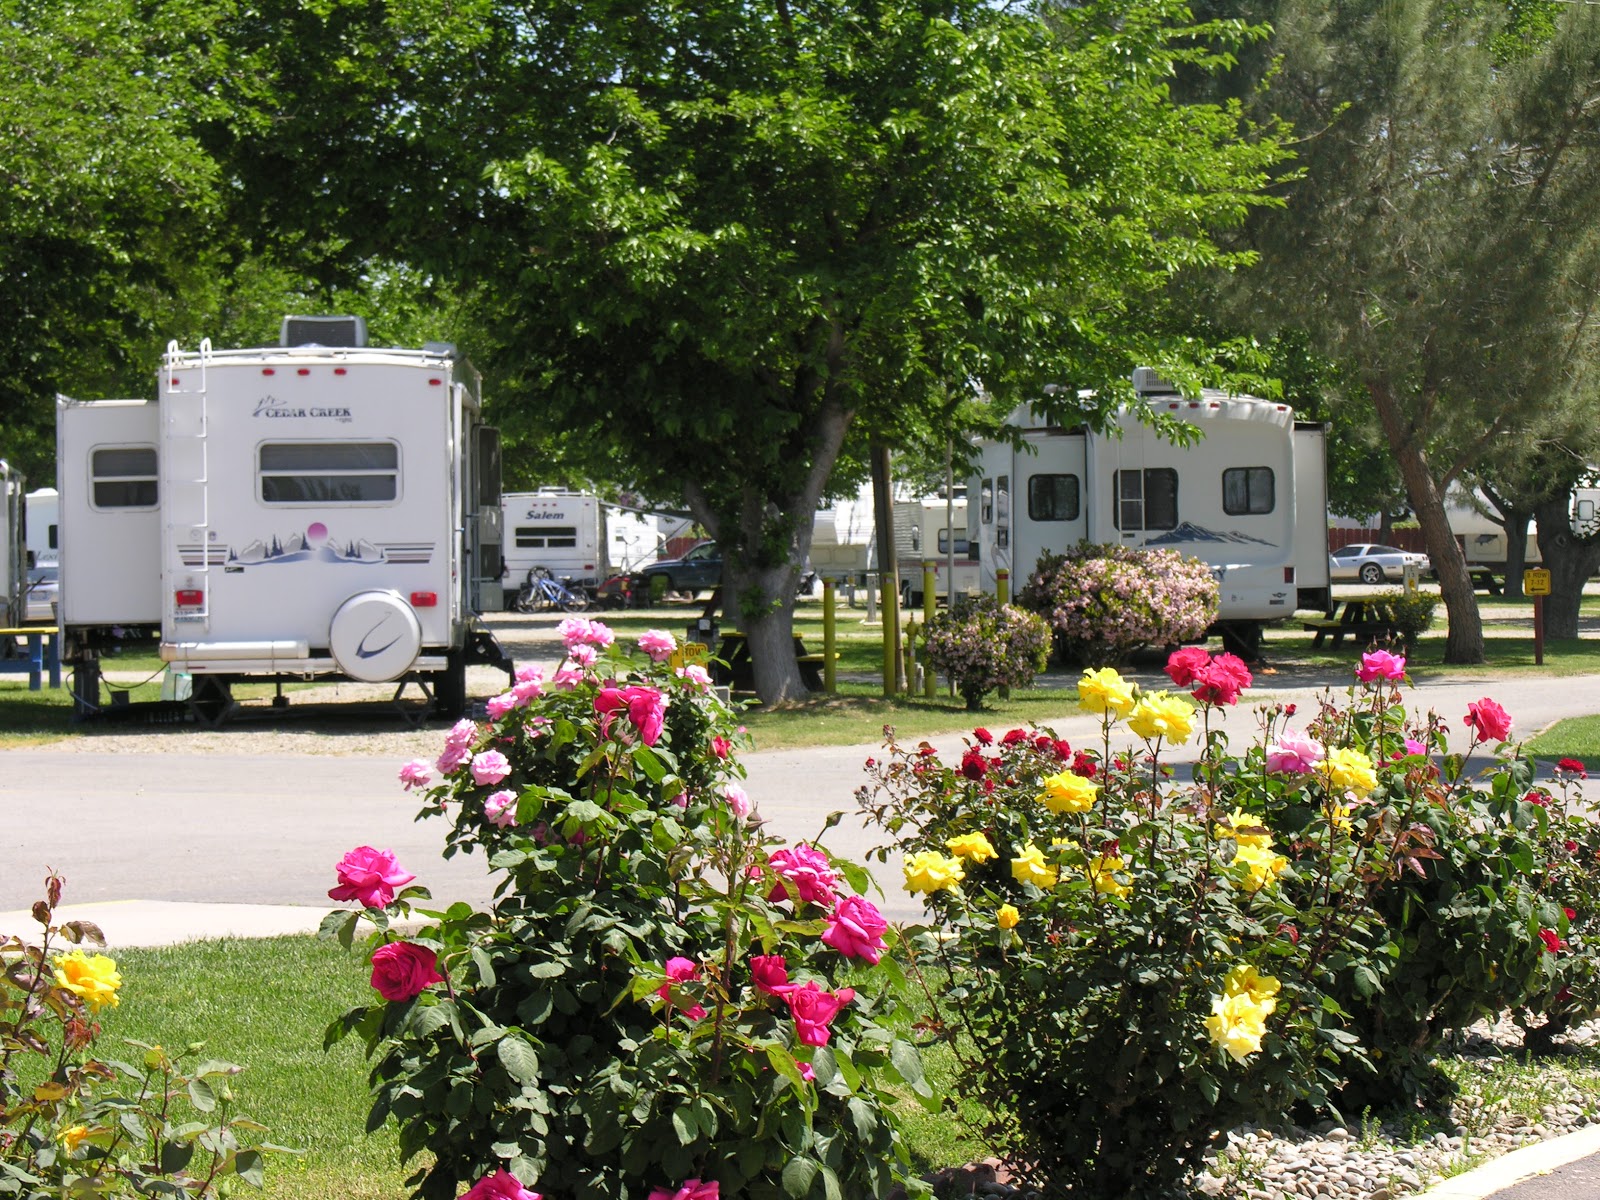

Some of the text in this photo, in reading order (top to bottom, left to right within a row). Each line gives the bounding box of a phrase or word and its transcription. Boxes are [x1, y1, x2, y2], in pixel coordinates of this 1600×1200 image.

[265, 407, 352, 418] CEDAR CREEK
[526, 510, 564, 520] Salem
